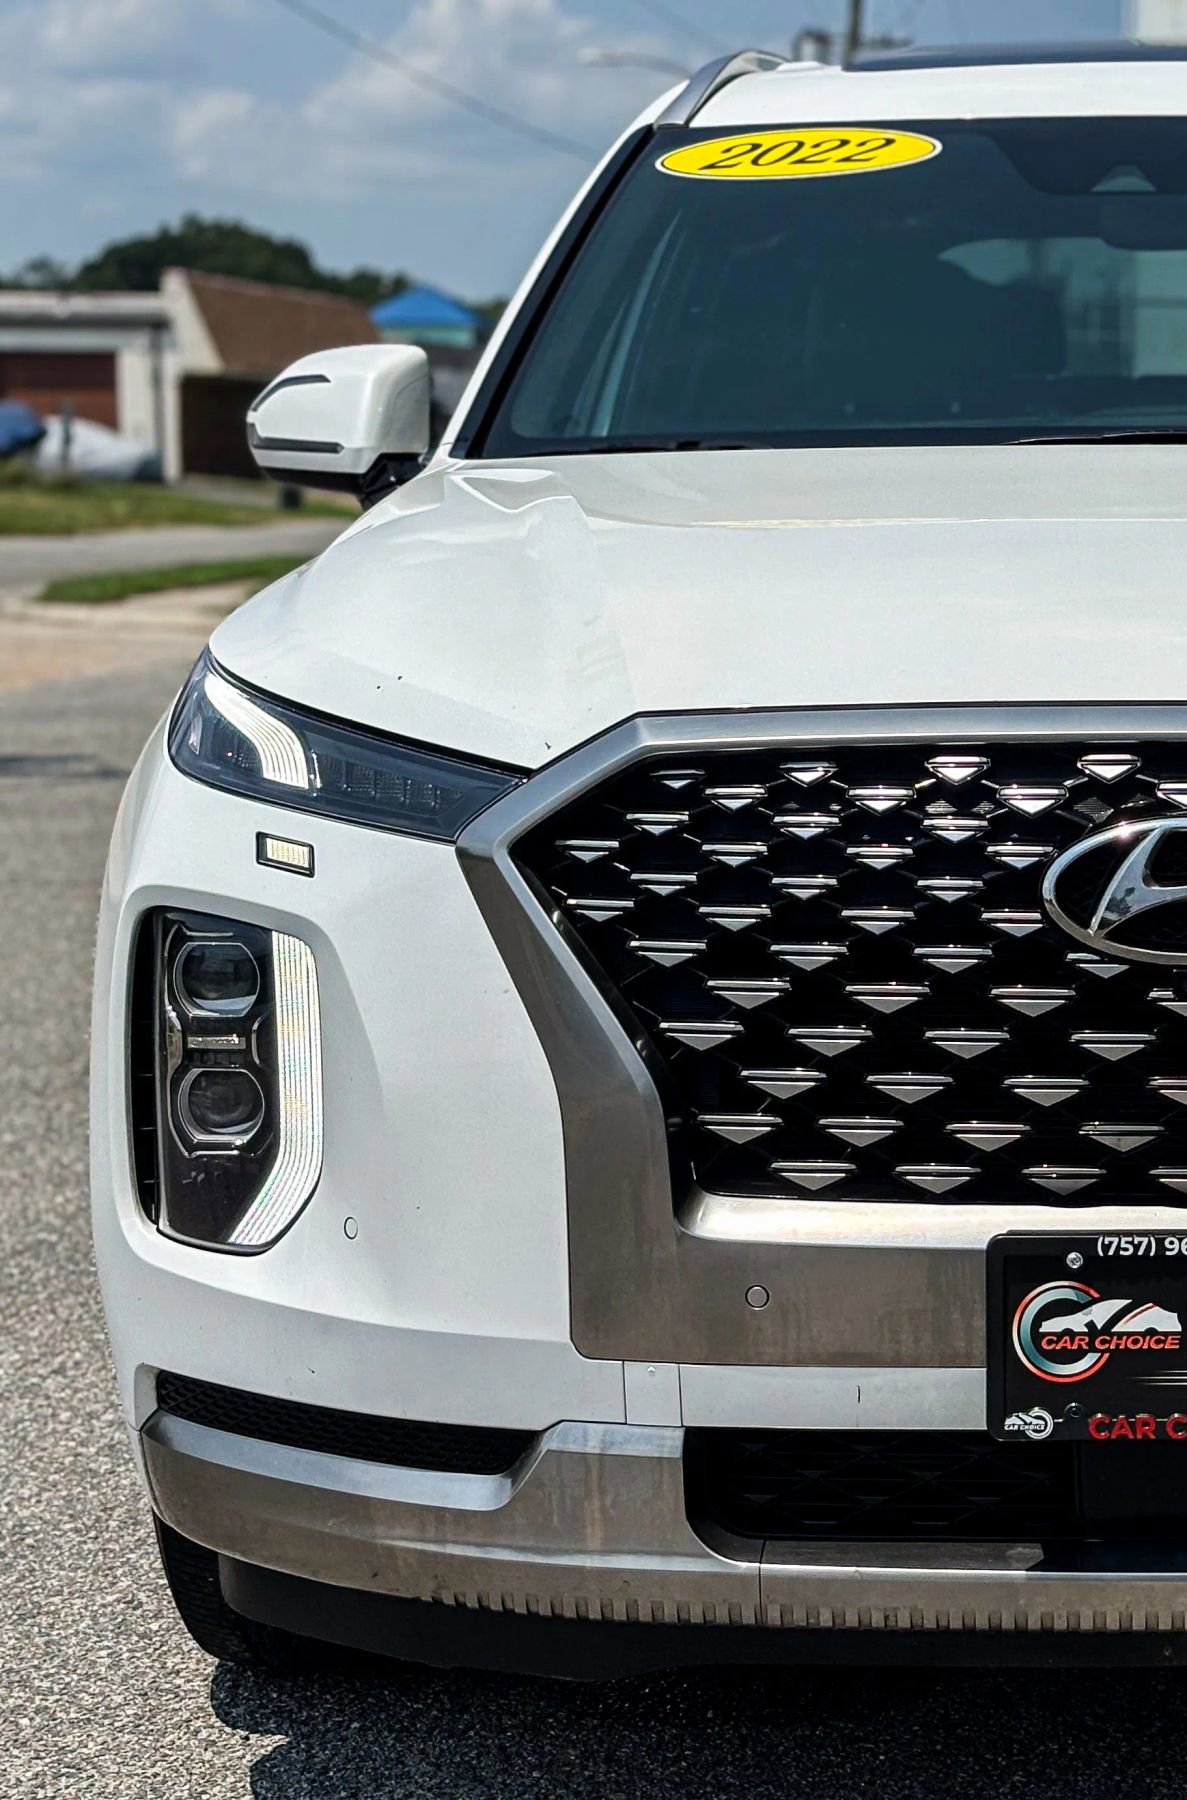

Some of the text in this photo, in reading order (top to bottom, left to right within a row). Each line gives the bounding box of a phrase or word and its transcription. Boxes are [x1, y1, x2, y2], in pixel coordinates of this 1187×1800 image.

[698, 137, 896, 171] 2022
[1097, 1236, 1156, 1256] (757)
[1041, 1335, 1181, 1350] CAR CHOICE
[1088, 1414, 1156, 1440] CAR
